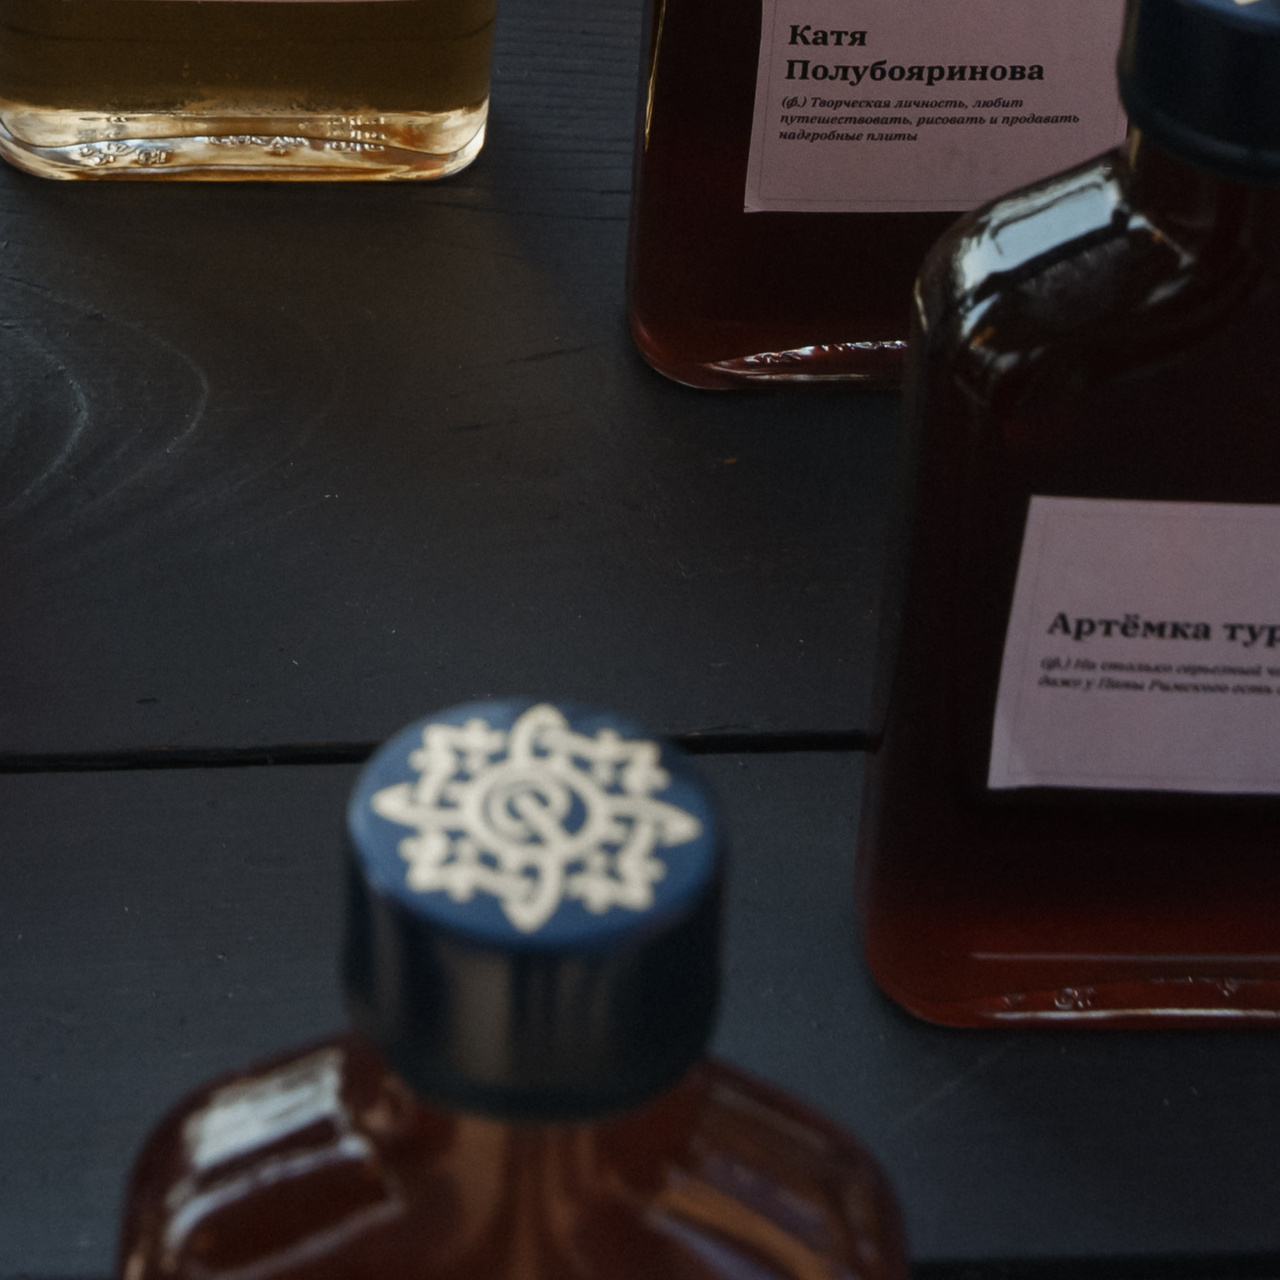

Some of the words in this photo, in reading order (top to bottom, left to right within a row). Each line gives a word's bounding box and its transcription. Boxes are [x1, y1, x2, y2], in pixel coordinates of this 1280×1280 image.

[787, 24, 868, 47] Катя
[784, 59, 1045, 87] Полубояринова
[781, 95, 808, 110] (ф.)
[810, 96, 891, 111] Творческая
[893, 99, 969, 110] личность,
[971, 97, 1024, 109] любит
[915, 116, 987, 128] рисовать
[989, 116, 999, 125] и
[1000, 112, 1080, 127] продавать
[778, 128, 864, 143] надгробные
[866, 132, 918, 142] плиты
[1047, 612, 1212, 642] Артёмка
